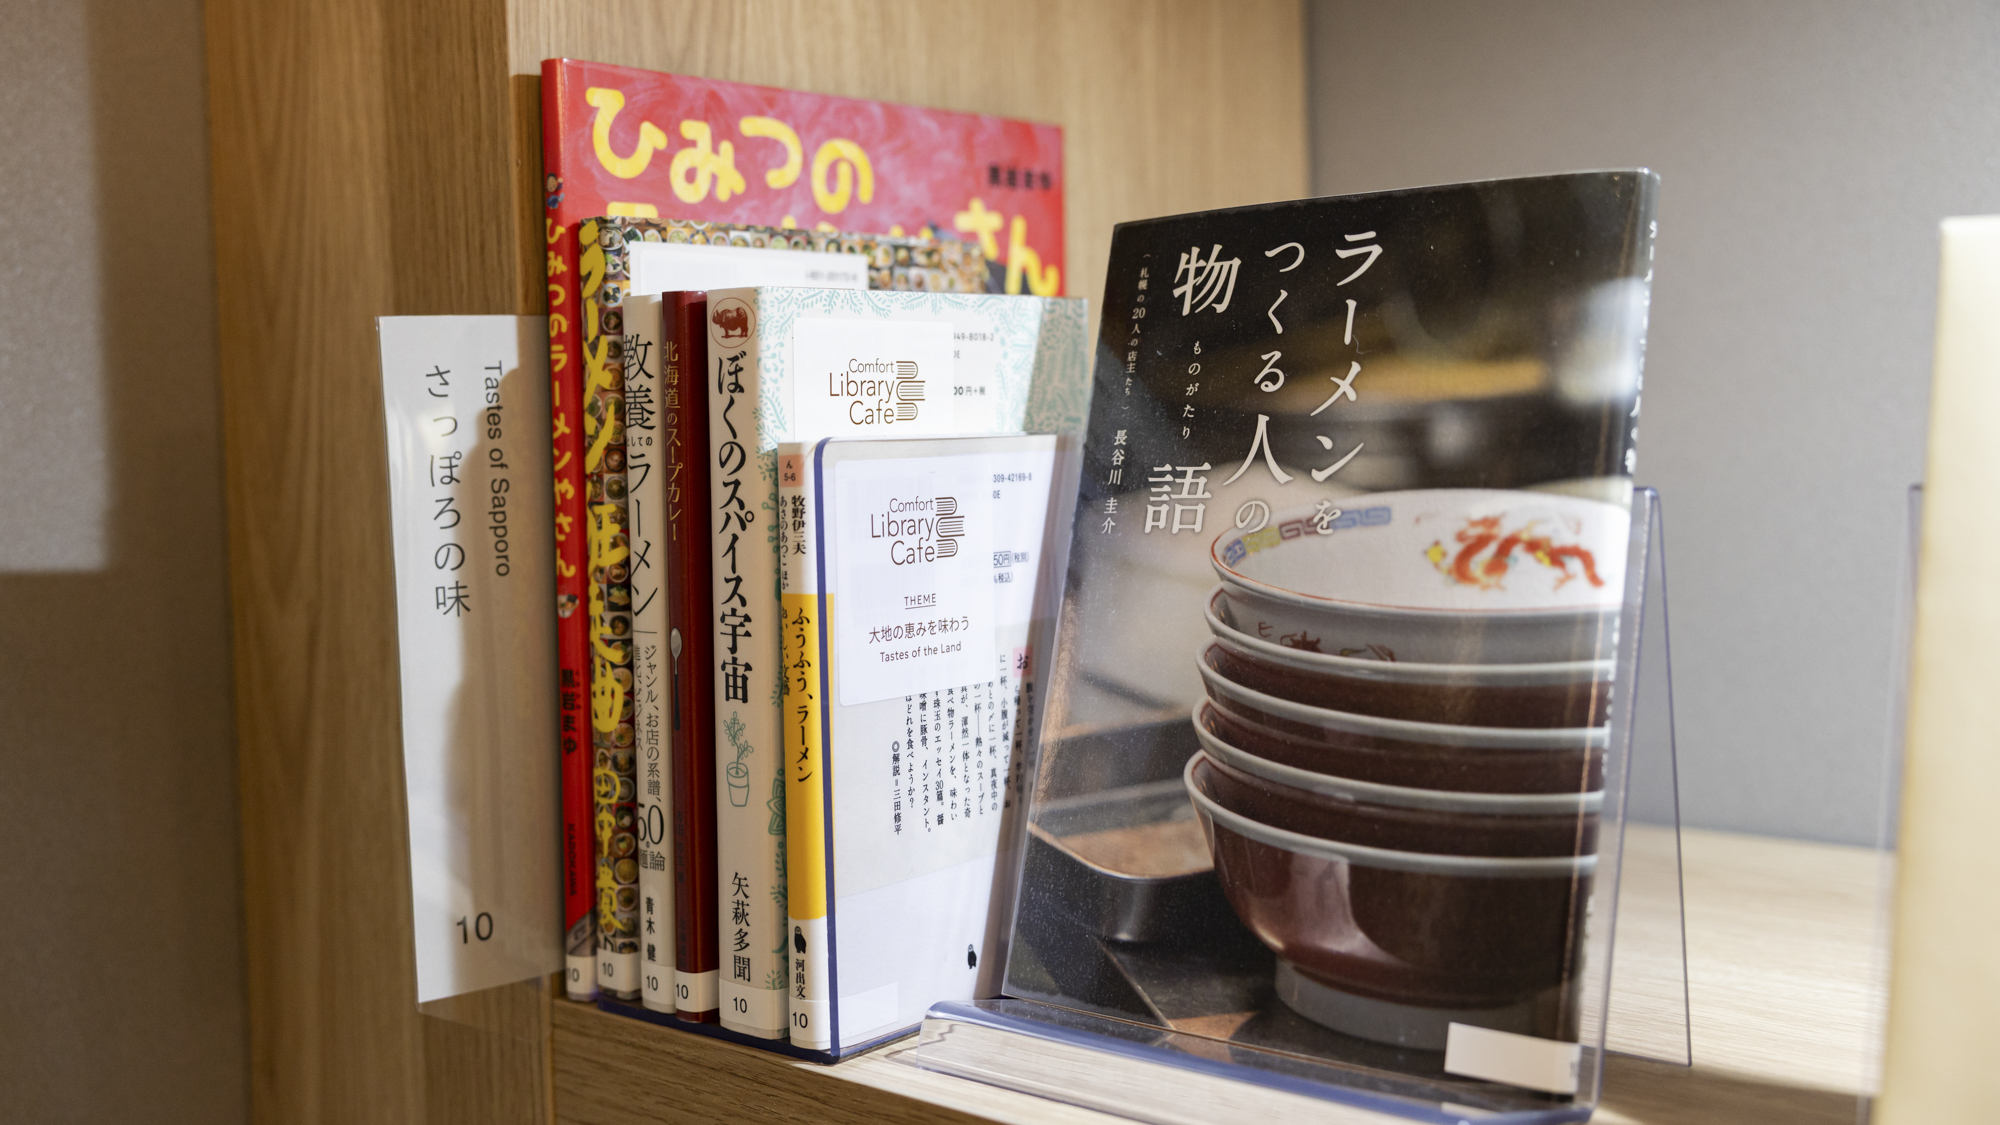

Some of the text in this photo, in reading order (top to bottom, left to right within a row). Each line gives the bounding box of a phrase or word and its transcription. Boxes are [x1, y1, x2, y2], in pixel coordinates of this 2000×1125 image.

[585, 86, 874, 214] ひみつの
[848, 358, 894, 373] Comfort
[546, 218, 576, 578] ひみつのラーメンやさん
[829, 371, 895, 403] Library
[1182, 340, 1202, 440] ものがたり
[1222, 241, 1305, 534] つくる人の
[1310, 230, 1383, 535] ラーメンを
[849, 399, 895, 425] Cafe
[663, 341, 683, 541] 北海道のスープカレー
[484, 360, 511, 577] Tastes of Sapporo
[784, 472, 796, 482] 5-6
[1101, 428, 1128, 535] 長谷川 圭介
[425, 365, 471, 617] さっぽろの味
[889, 496, 934, 513] Comfort
[717, 350, 754, 704] ぼくのスパイス宇宙
[791, 494, 807, 555] 牧野伊三夫
[871, 511, 935, 541] Library
[891, 537, 935, 566] Cafe
[904, 593, 937, 606] THEME
[868, 616, 970, 645] 大地の恵みを味わう
[880, 641, 962, 663] Tastes of the Land
[792, 607, 814, 783] ふうふう、ラーメン
[567, 823, 577, 897] KADOKAWA
[456, 911, 494, 944] 10
[731, 871, 751, 983] 矢萩多聞
[602, 962, 614, 977] 10
[646, 975, 659, 991] 10
[795, 958, 806, 1000] 河出文
[676, 983, 689, 999] 10
[733, 996, 747, 1014] 10
[792, 1011, 808, 1029] 10
